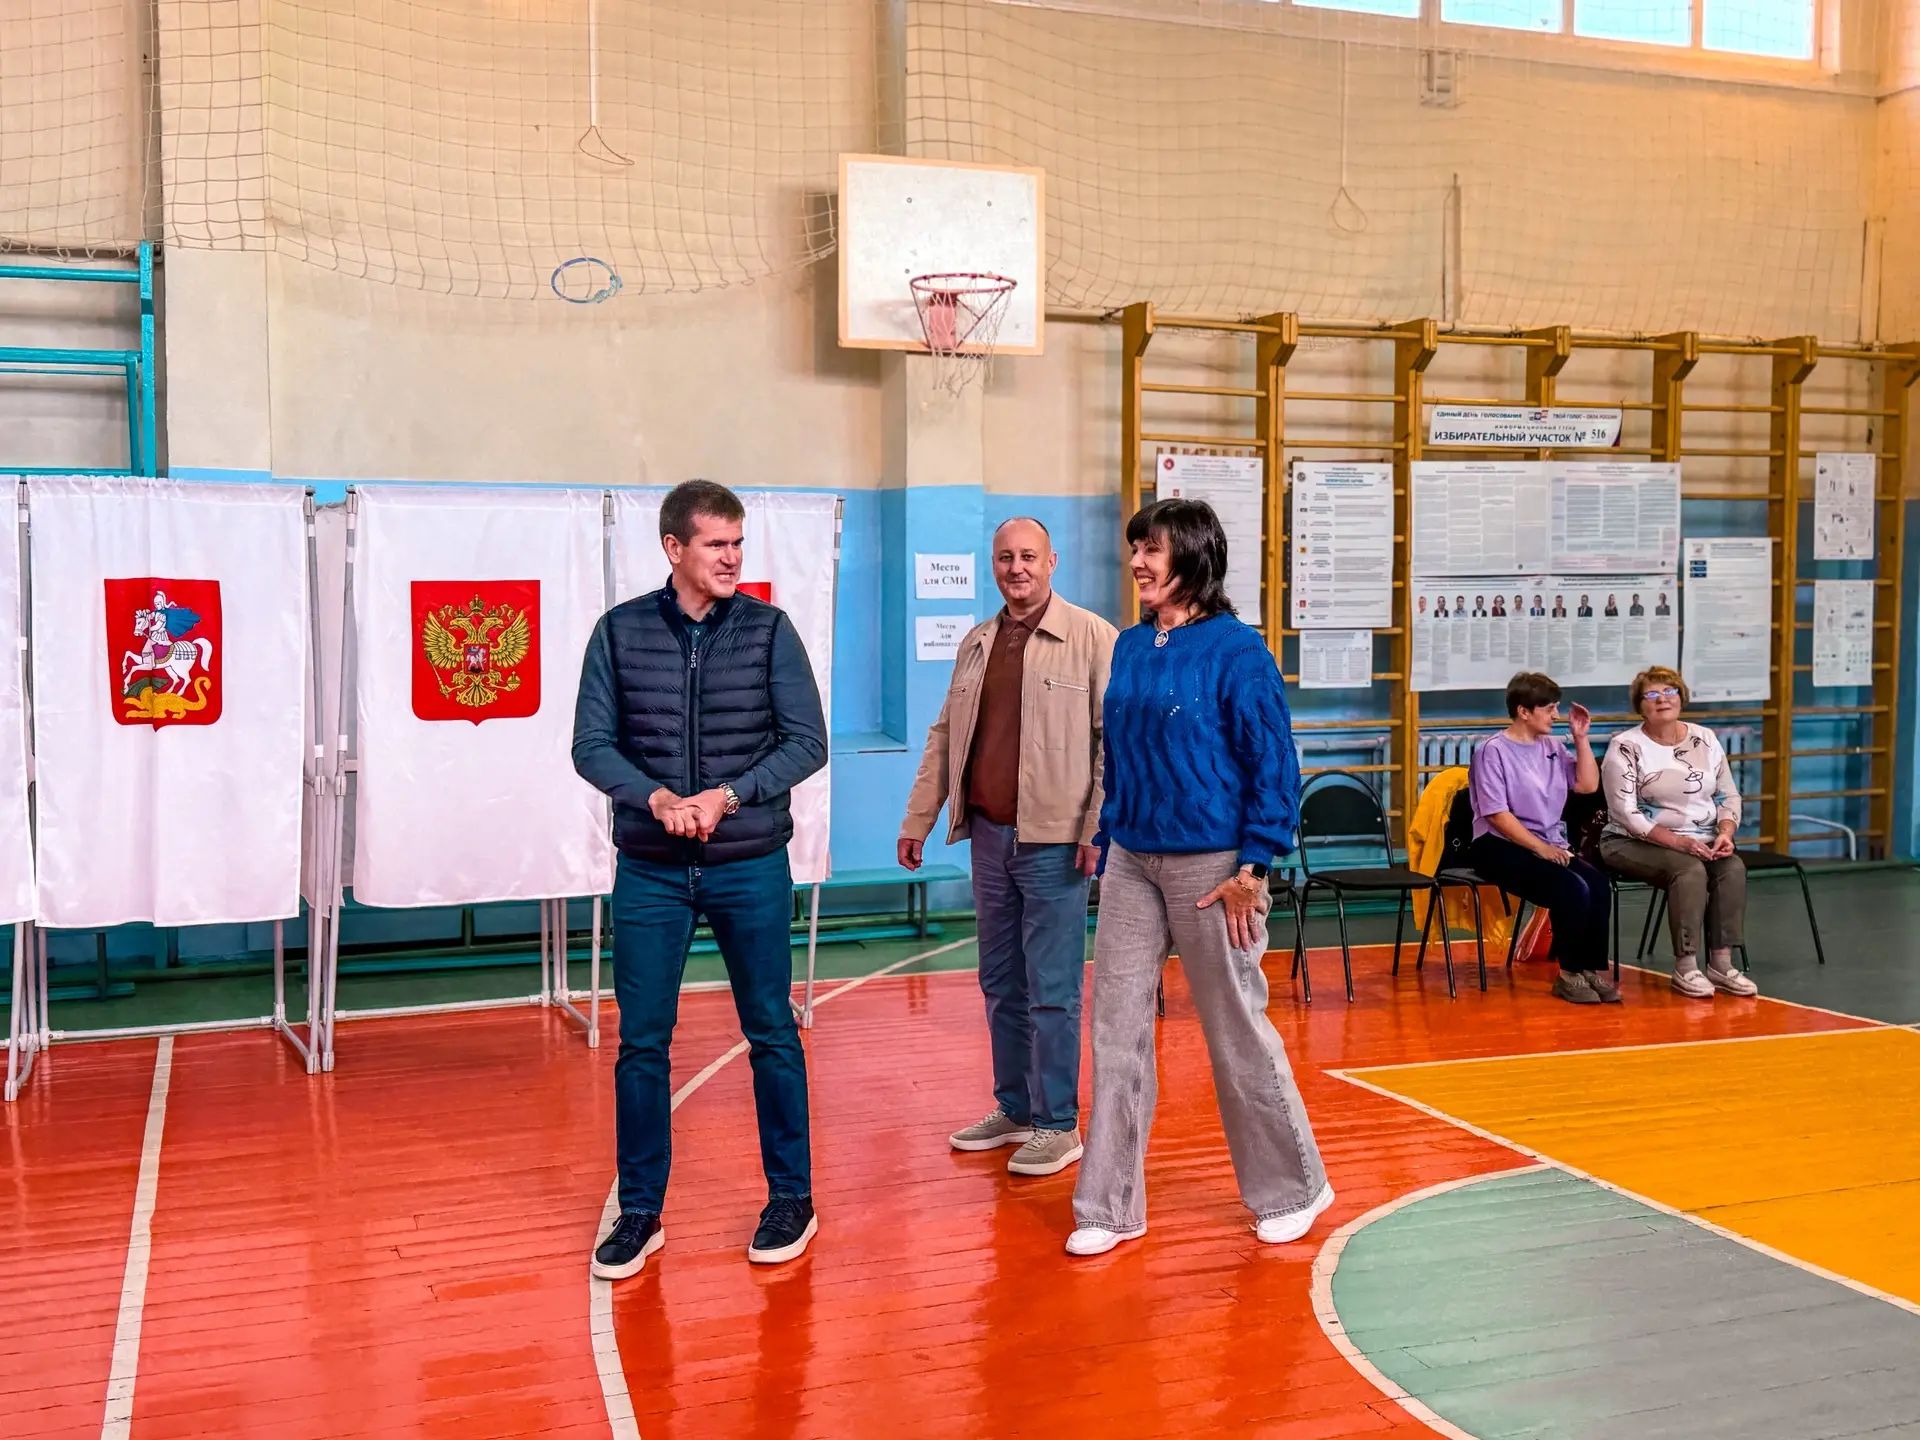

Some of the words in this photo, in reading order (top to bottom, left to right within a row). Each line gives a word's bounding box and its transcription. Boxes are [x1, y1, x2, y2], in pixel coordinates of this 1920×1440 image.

[1434, 431, 1526, 442] ИЗБИРАТЕЛЬНЫЙ
[1529, 433, 1571, 443] УЧАСТОК
[1591, 429, 1607, 440] 516
[930, 563, 960, 571] Место
[942, 575, 968, 586] СМИ
